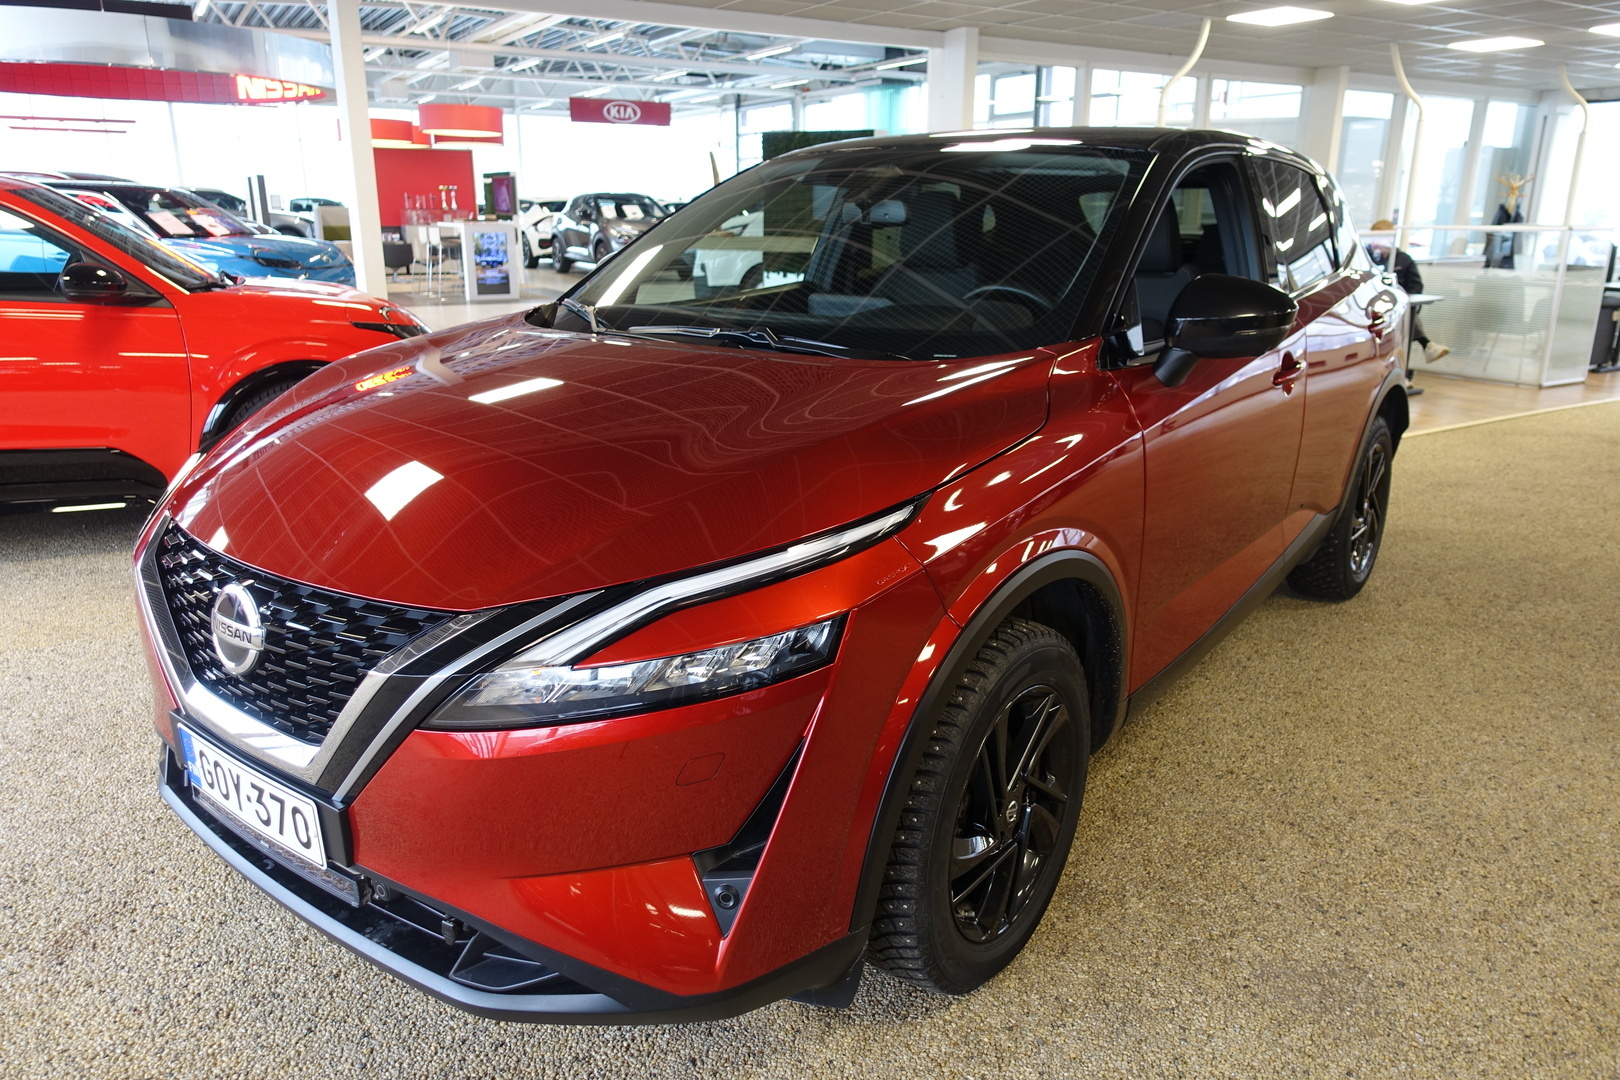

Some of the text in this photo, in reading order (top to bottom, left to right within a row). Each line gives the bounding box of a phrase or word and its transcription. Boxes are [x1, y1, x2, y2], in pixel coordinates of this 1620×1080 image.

[610, 105, 636, 119] KIA
[212, 616, 252, 645] NISSAN
[199, 750, 312, 849] GOY-370
